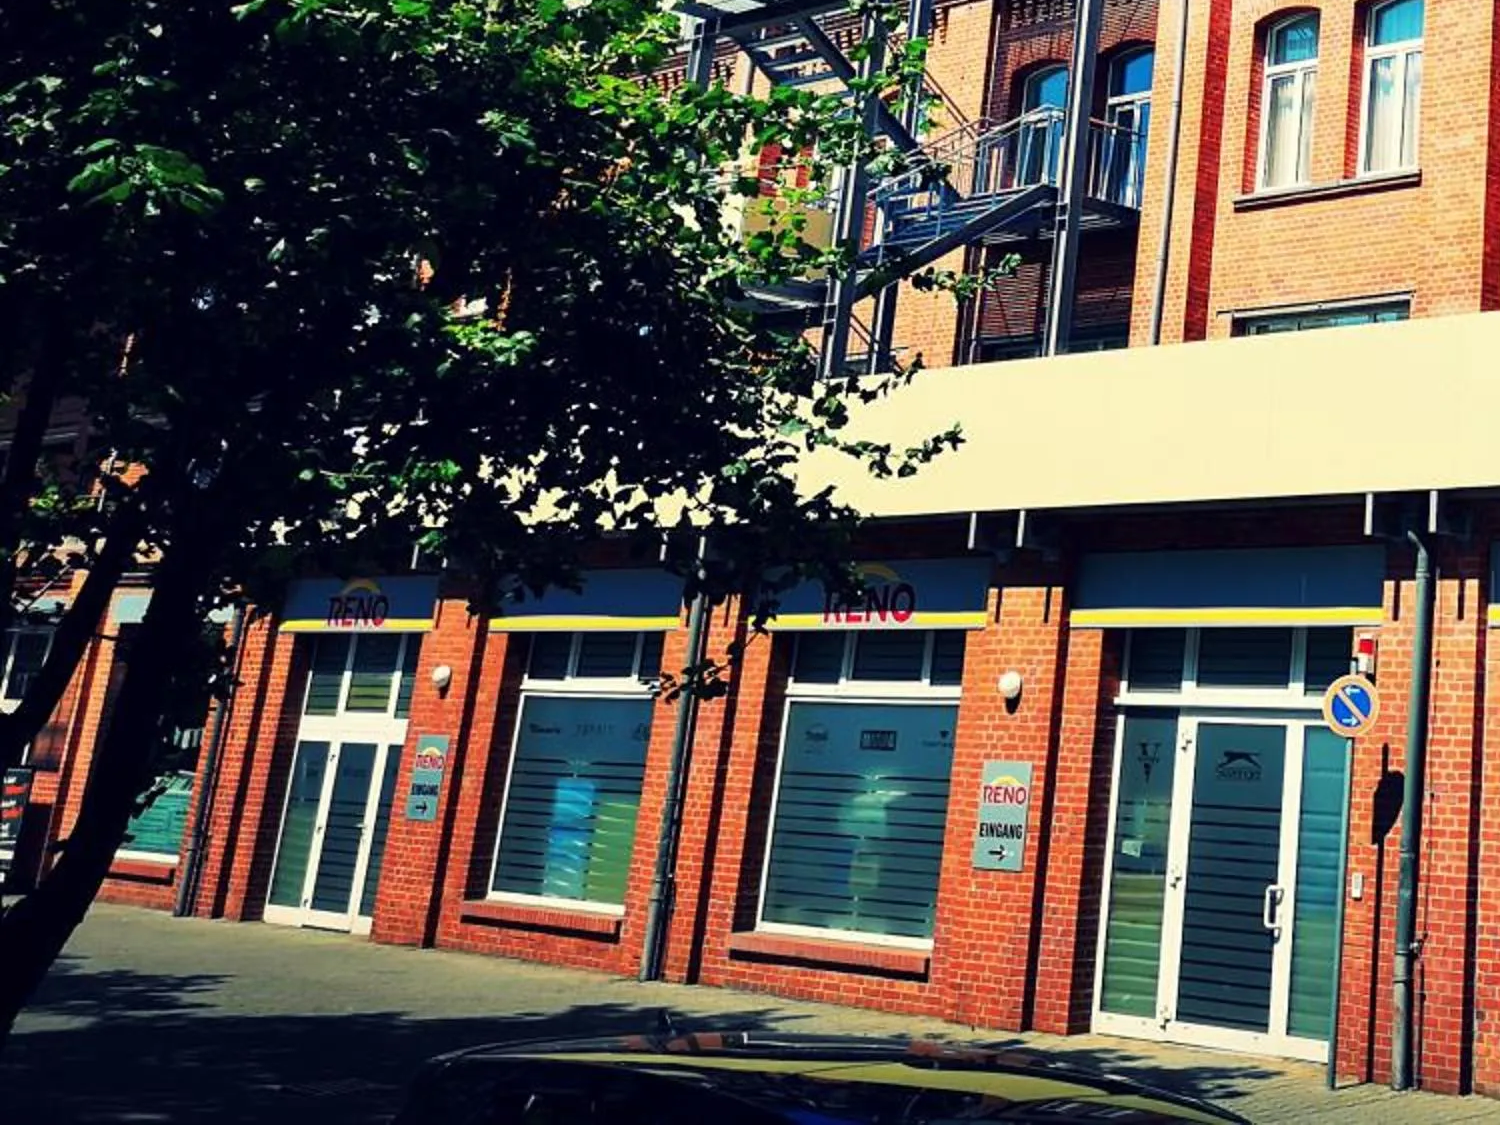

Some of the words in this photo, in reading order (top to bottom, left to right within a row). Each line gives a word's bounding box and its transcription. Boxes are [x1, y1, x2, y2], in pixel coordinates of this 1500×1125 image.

[326, 594, 389, 628] RENO
[983, 785, 1027, 805] RENO
[979, 821, 1023, 840] EINGANG
